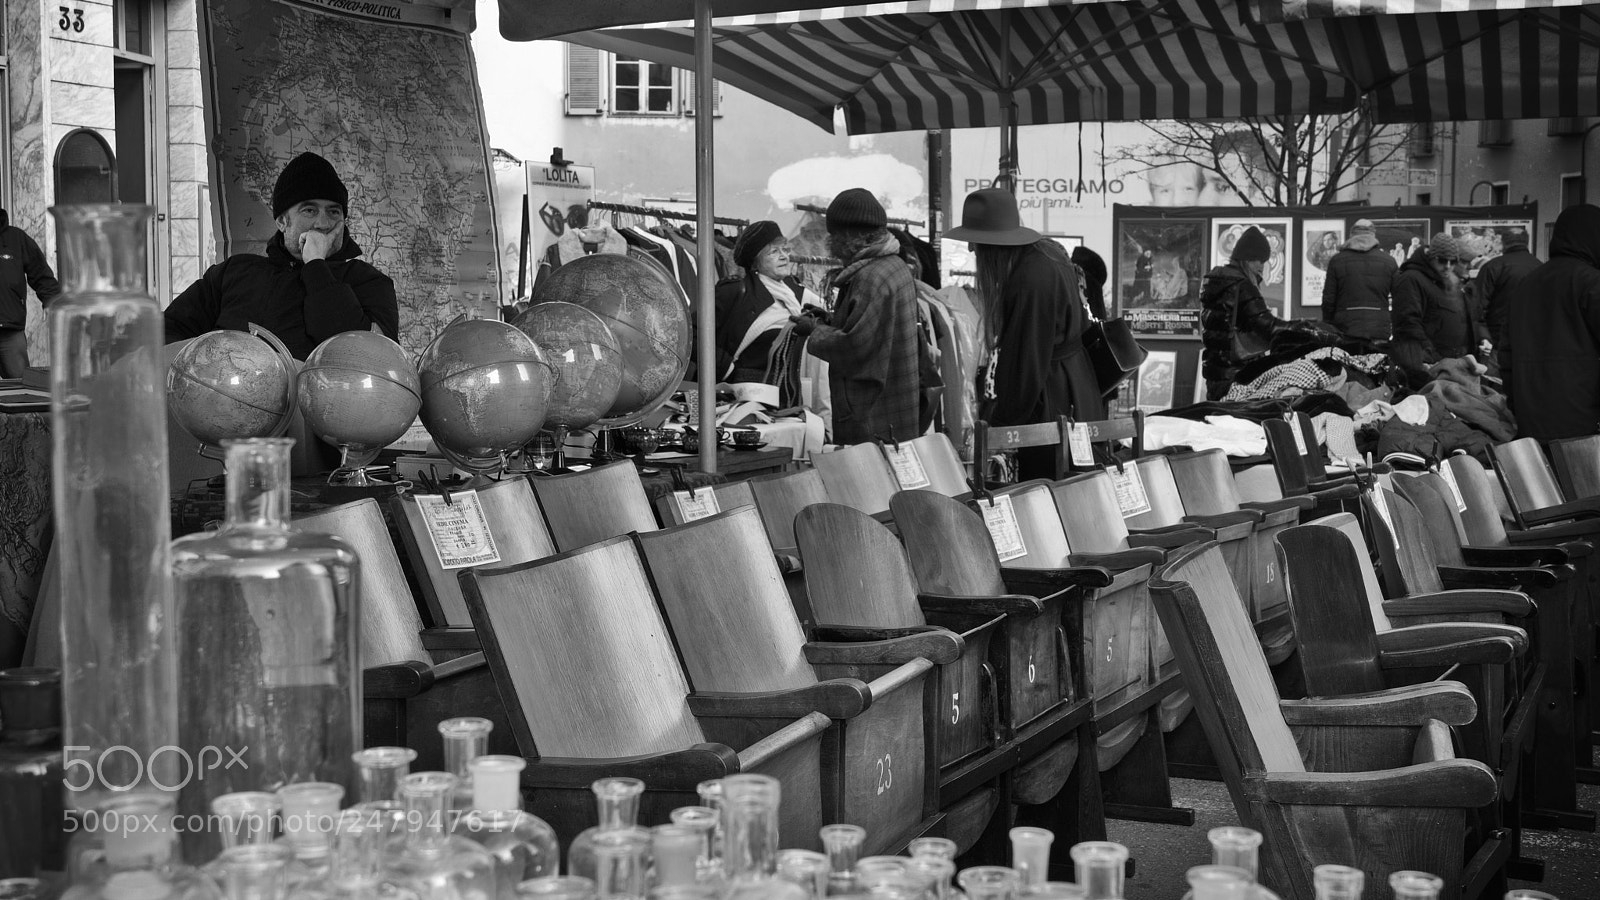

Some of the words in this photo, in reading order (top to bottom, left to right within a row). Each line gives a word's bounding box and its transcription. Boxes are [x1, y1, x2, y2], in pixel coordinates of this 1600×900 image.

[59, 6, 85, 33] 33
[964, 178, 1124, 194] PREGGIAMO
[1006, 430, 1020, 443] 32
[1028, 655, 1036, 684] 6
[951, 692, 960, 725] 5
[876, 753, 893, 796] 23
